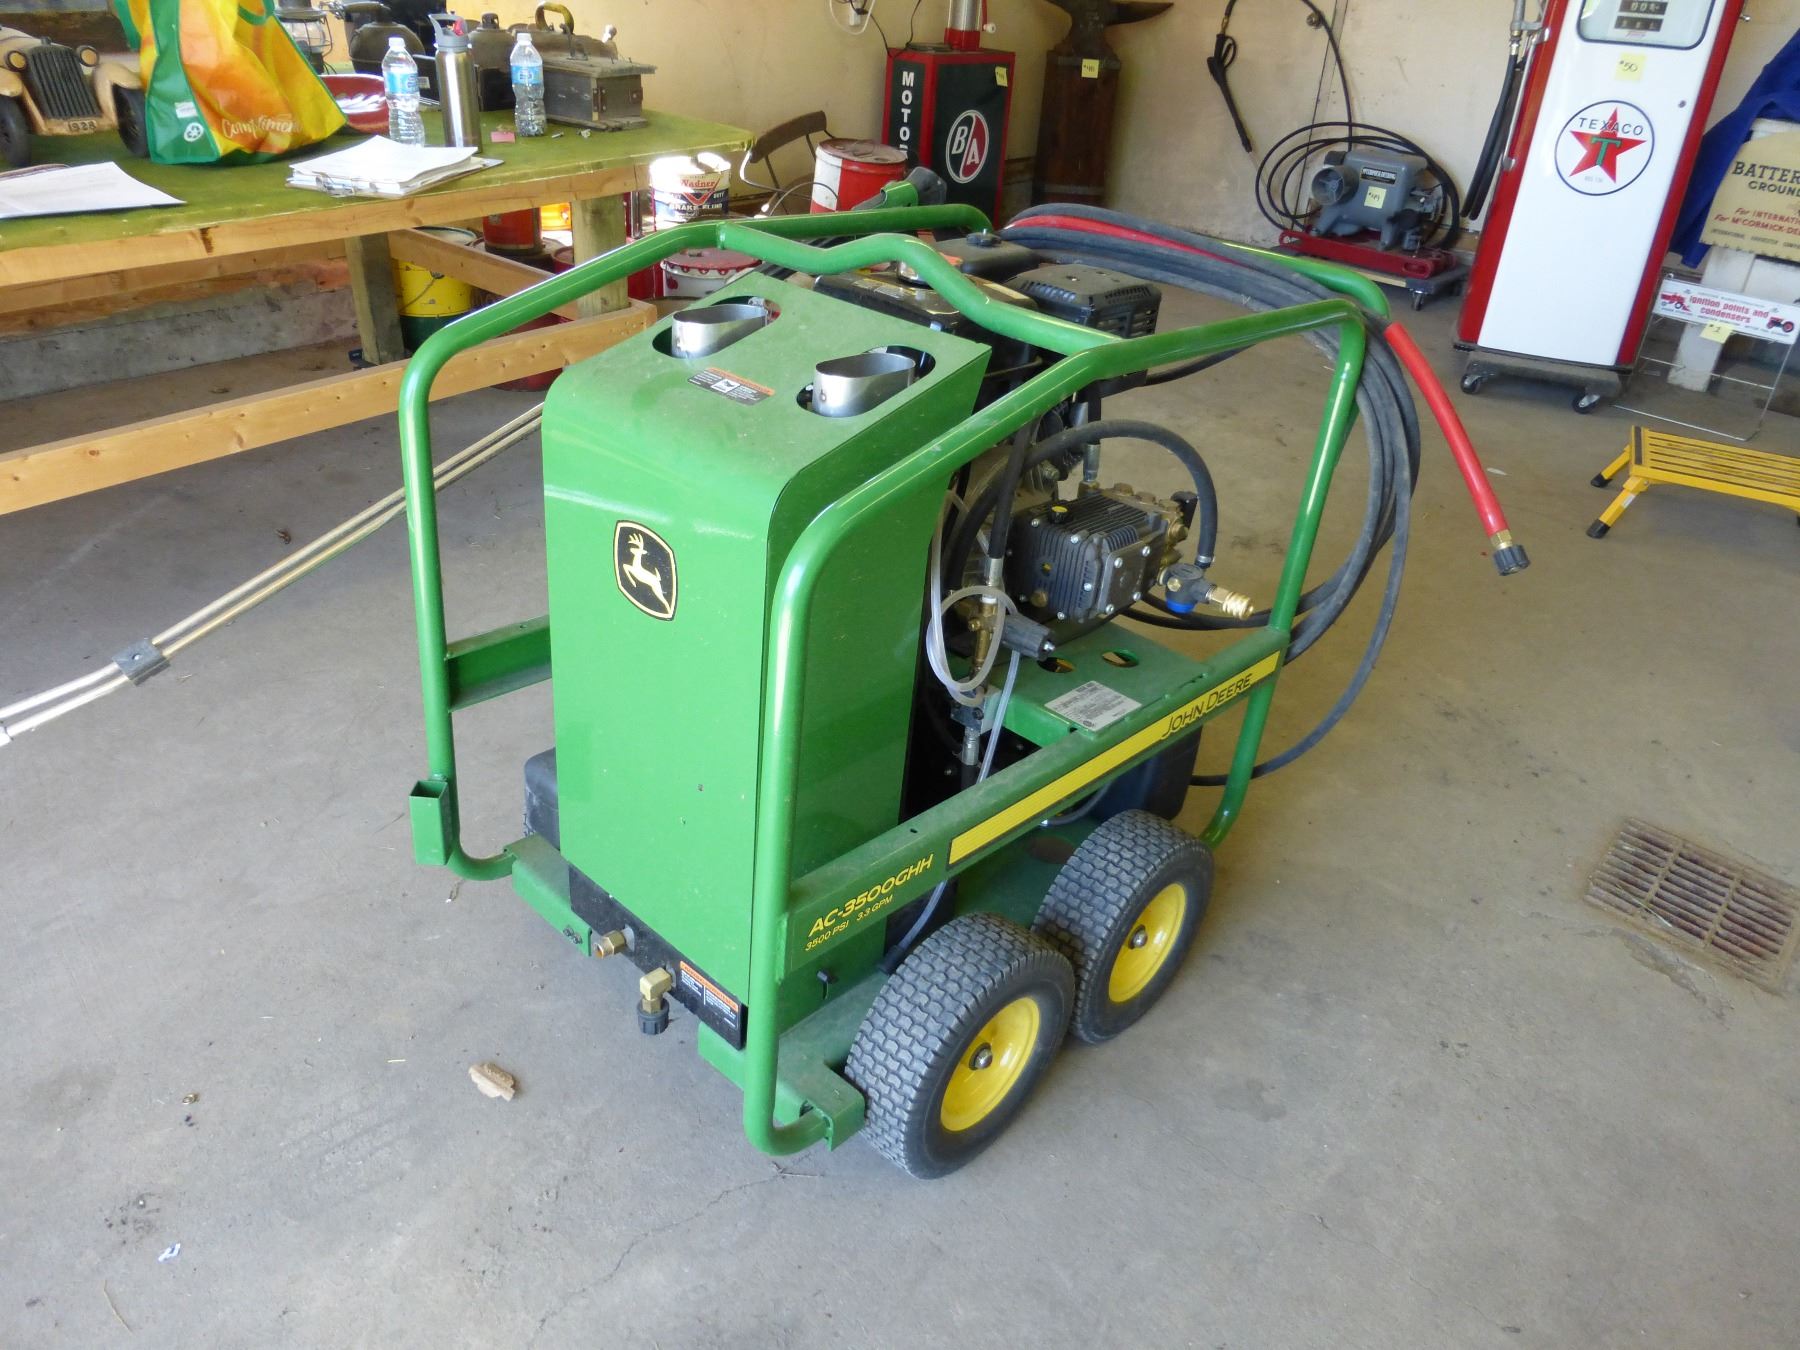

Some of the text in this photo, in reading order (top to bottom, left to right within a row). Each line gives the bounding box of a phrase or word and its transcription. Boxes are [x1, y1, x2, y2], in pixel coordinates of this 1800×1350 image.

[1578, 117, 1644, 136] TEXACO
[1700, 306, 1752, 324] condensers
[1161, 700, 1205, 738] JOHN
[1205, 673, 1254, 711] DEERE
[805, 930, 831, 952] 3500
[832, 920, 850, 936] PSI
[871, 895, 894, 912] GPM
[808, 853, 934, 938] AC-3500GHH
